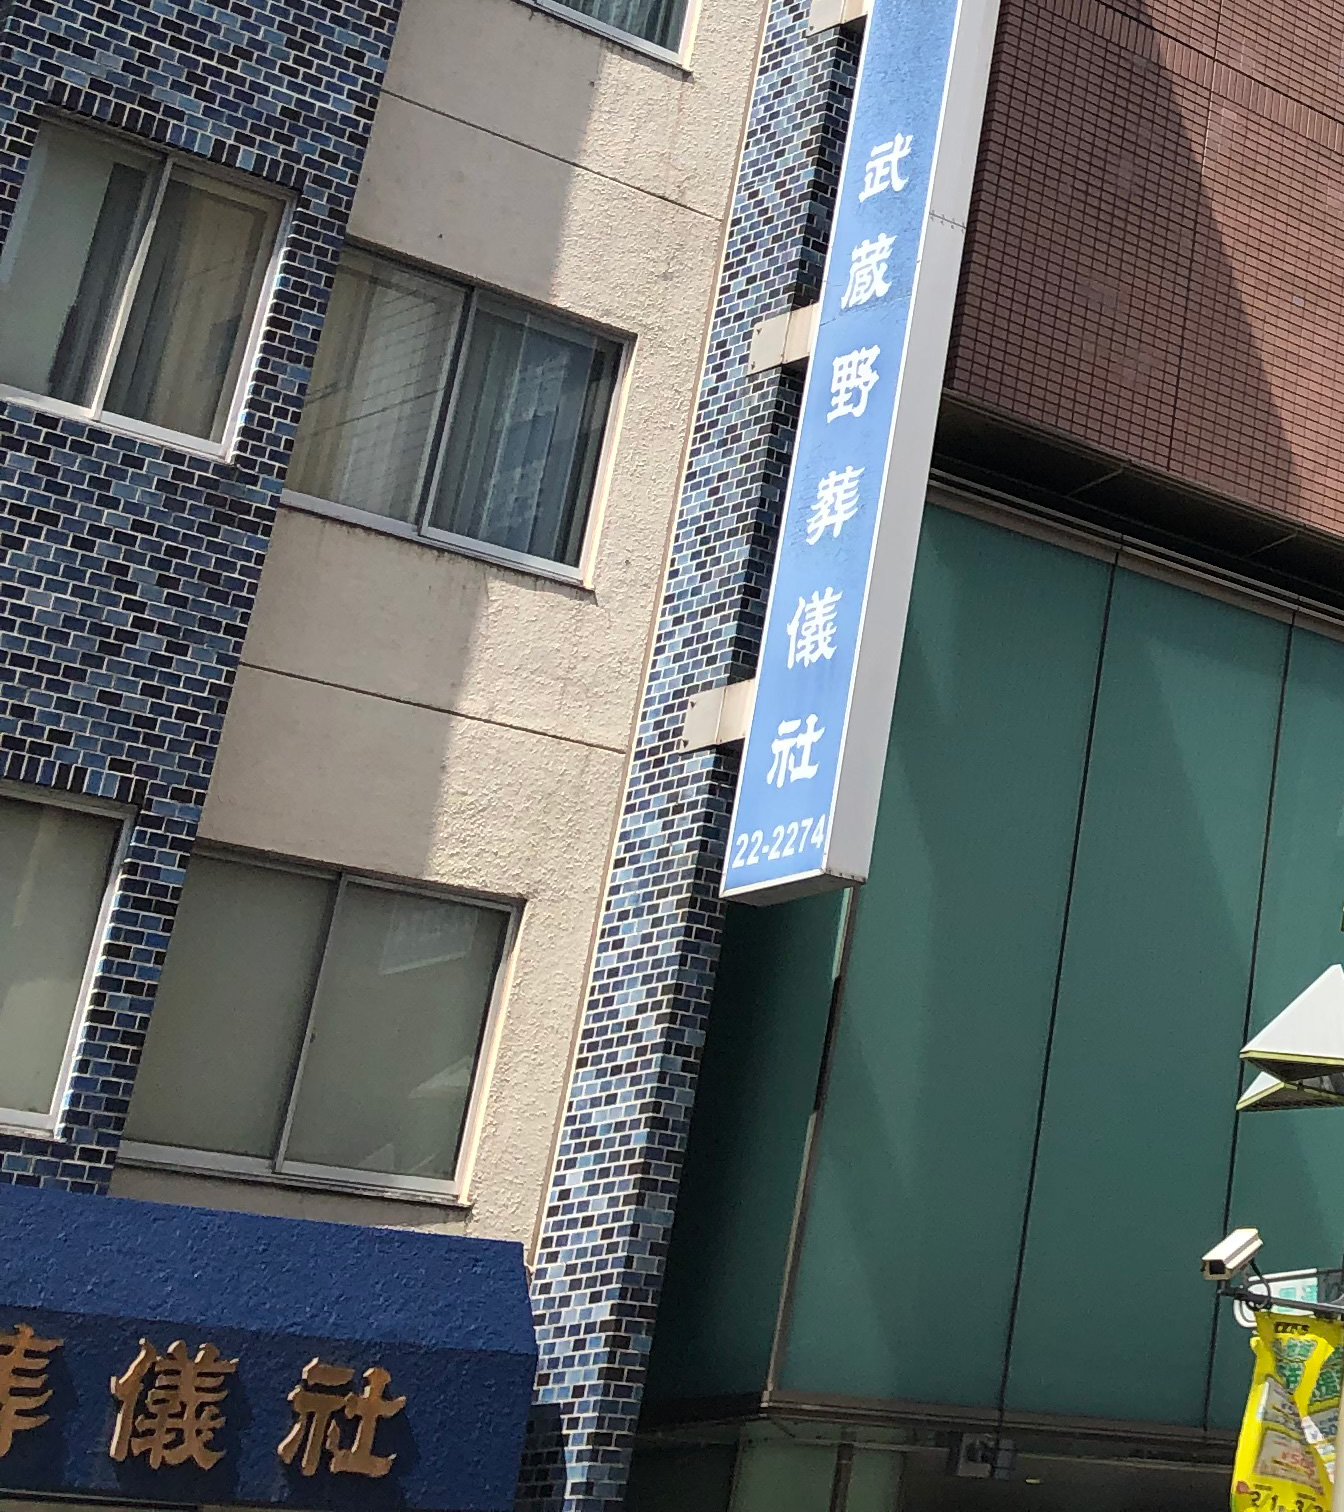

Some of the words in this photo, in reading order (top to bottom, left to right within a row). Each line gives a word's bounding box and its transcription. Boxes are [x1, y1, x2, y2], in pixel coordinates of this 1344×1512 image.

[766, 132, 914, 789] 武蔵野葬儀社
[732, 813, 826, 869] 22-2274
